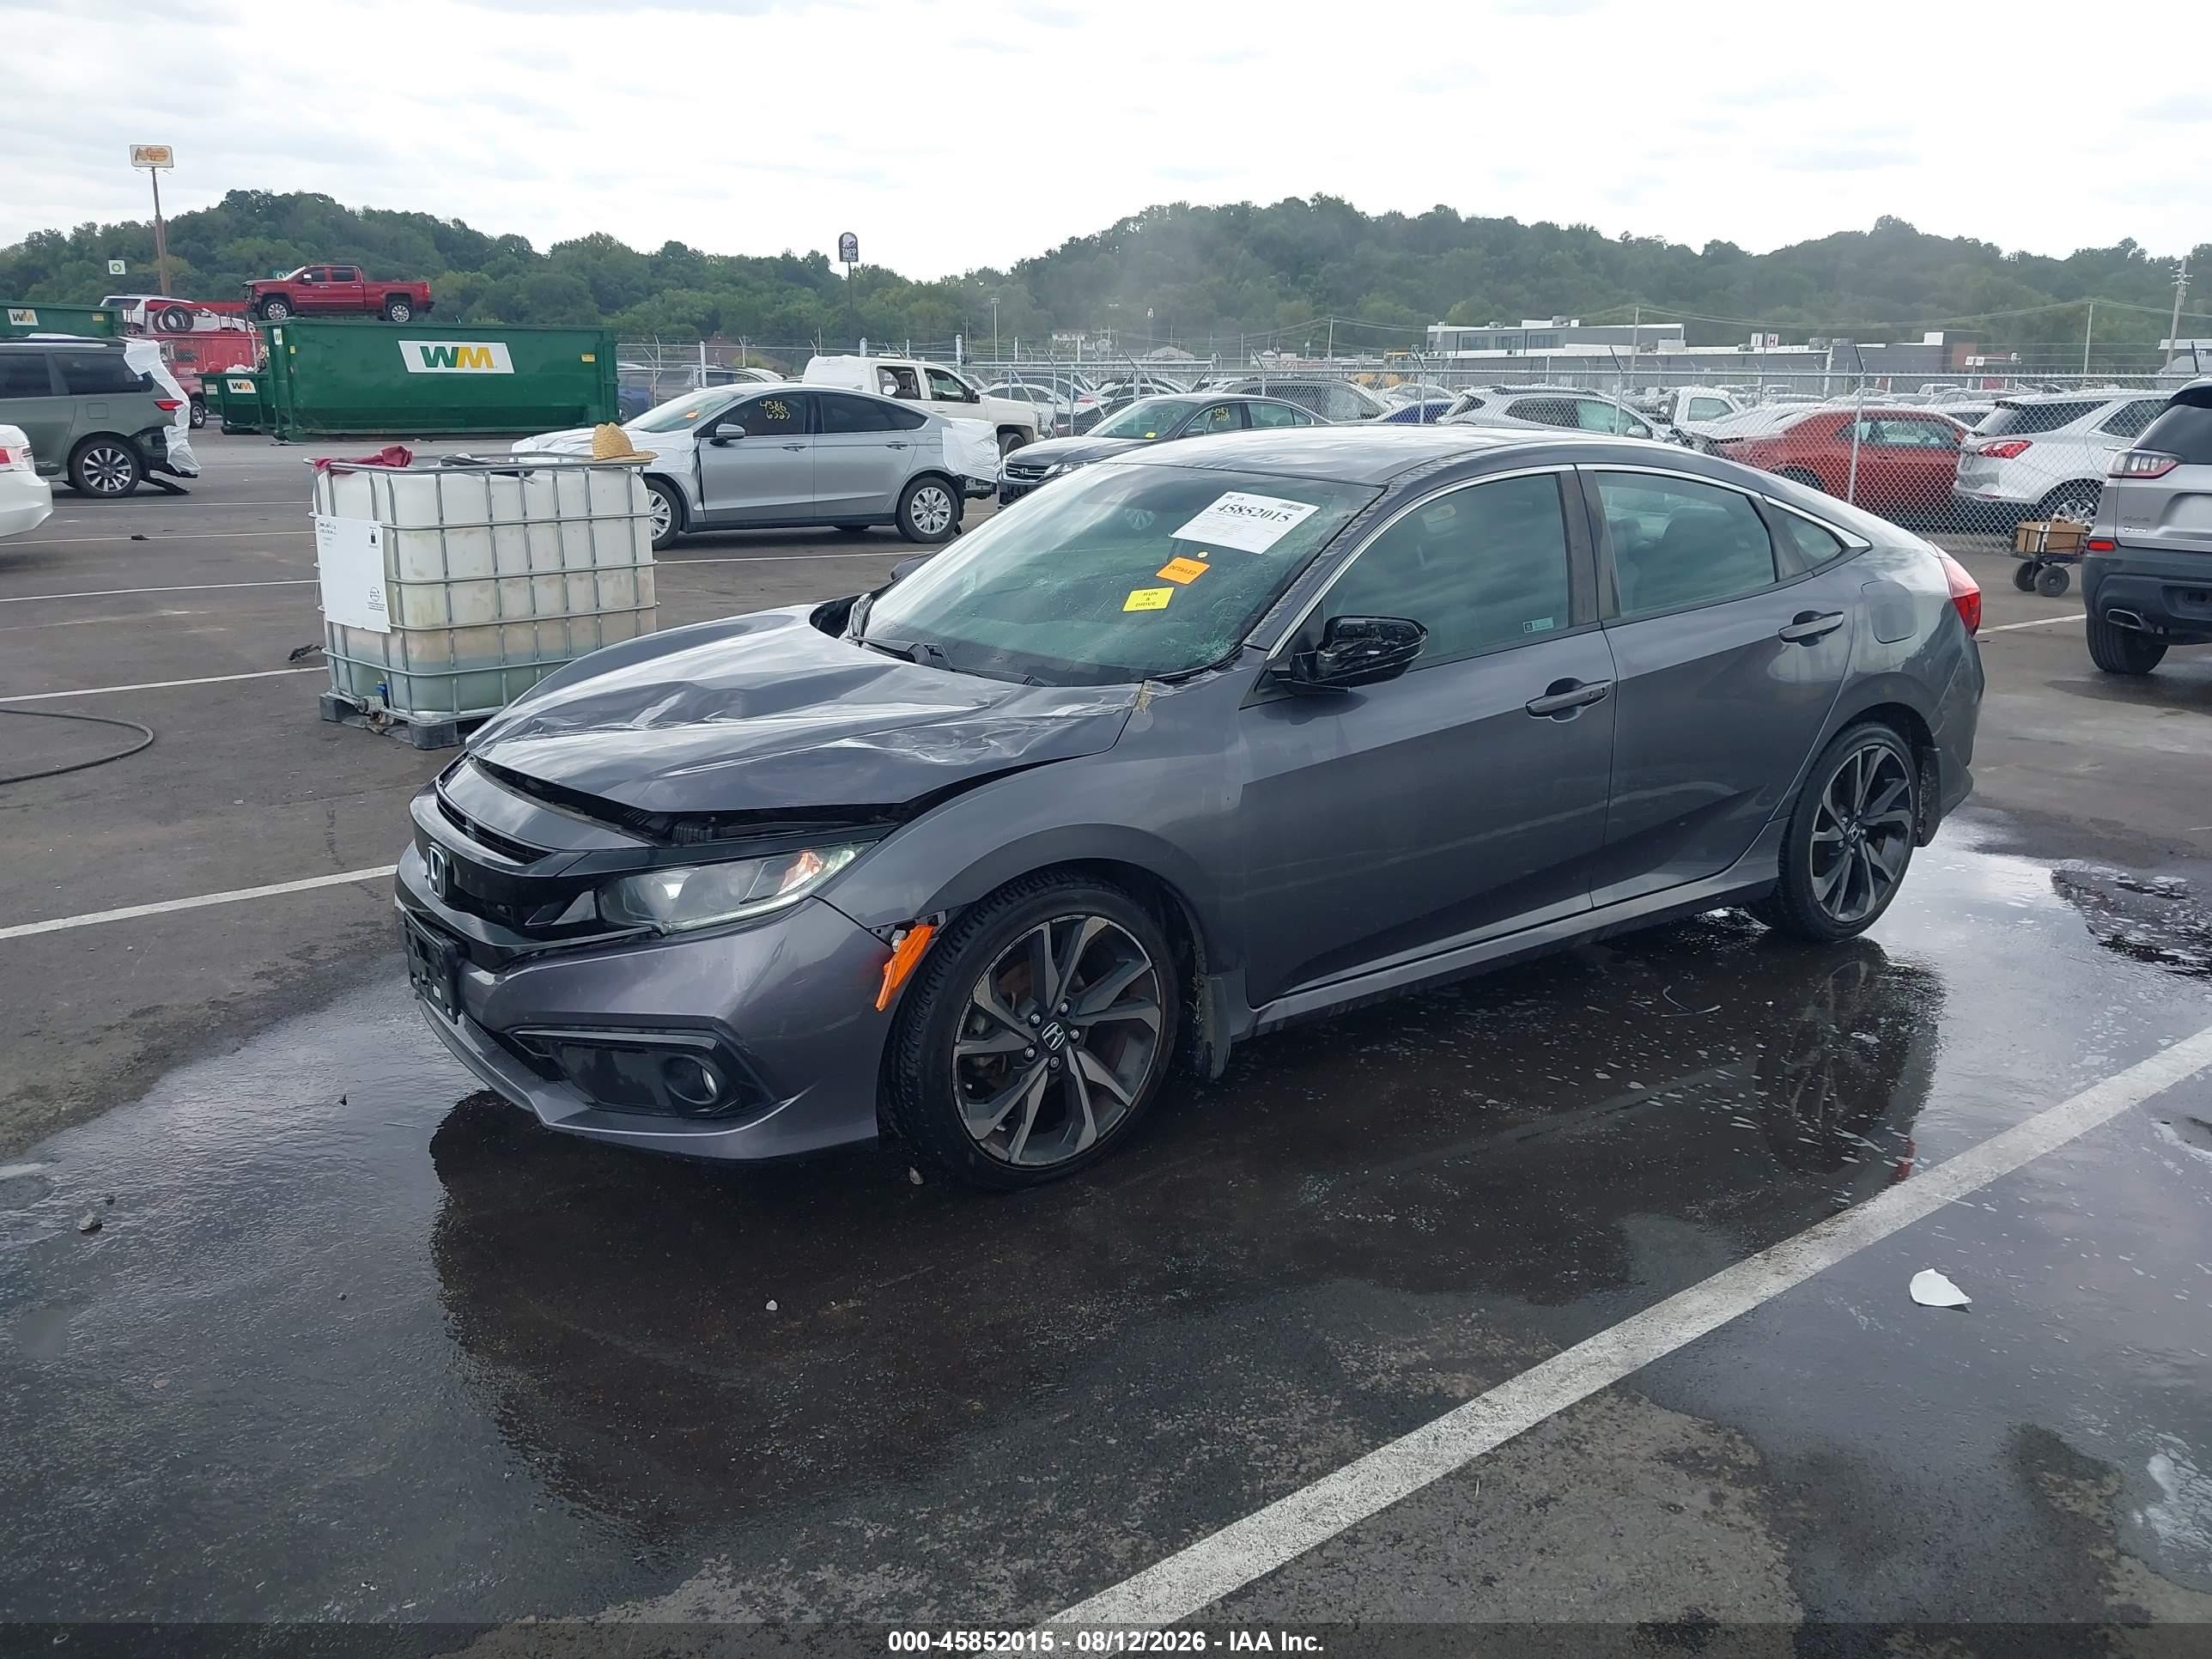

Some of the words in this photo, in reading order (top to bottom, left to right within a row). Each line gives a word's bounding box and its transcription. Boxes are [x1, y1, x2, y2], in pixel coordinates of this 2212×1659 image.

[12, 311, 34, 322] WM
[419, 345, 495, 369] WM
[231, 382, 252, 391] WM
[759, 399, 787, 411] 4586
[1217, 503, 1293, 523] 45852015
[1168, 564, 1198, 576] DETAILED
